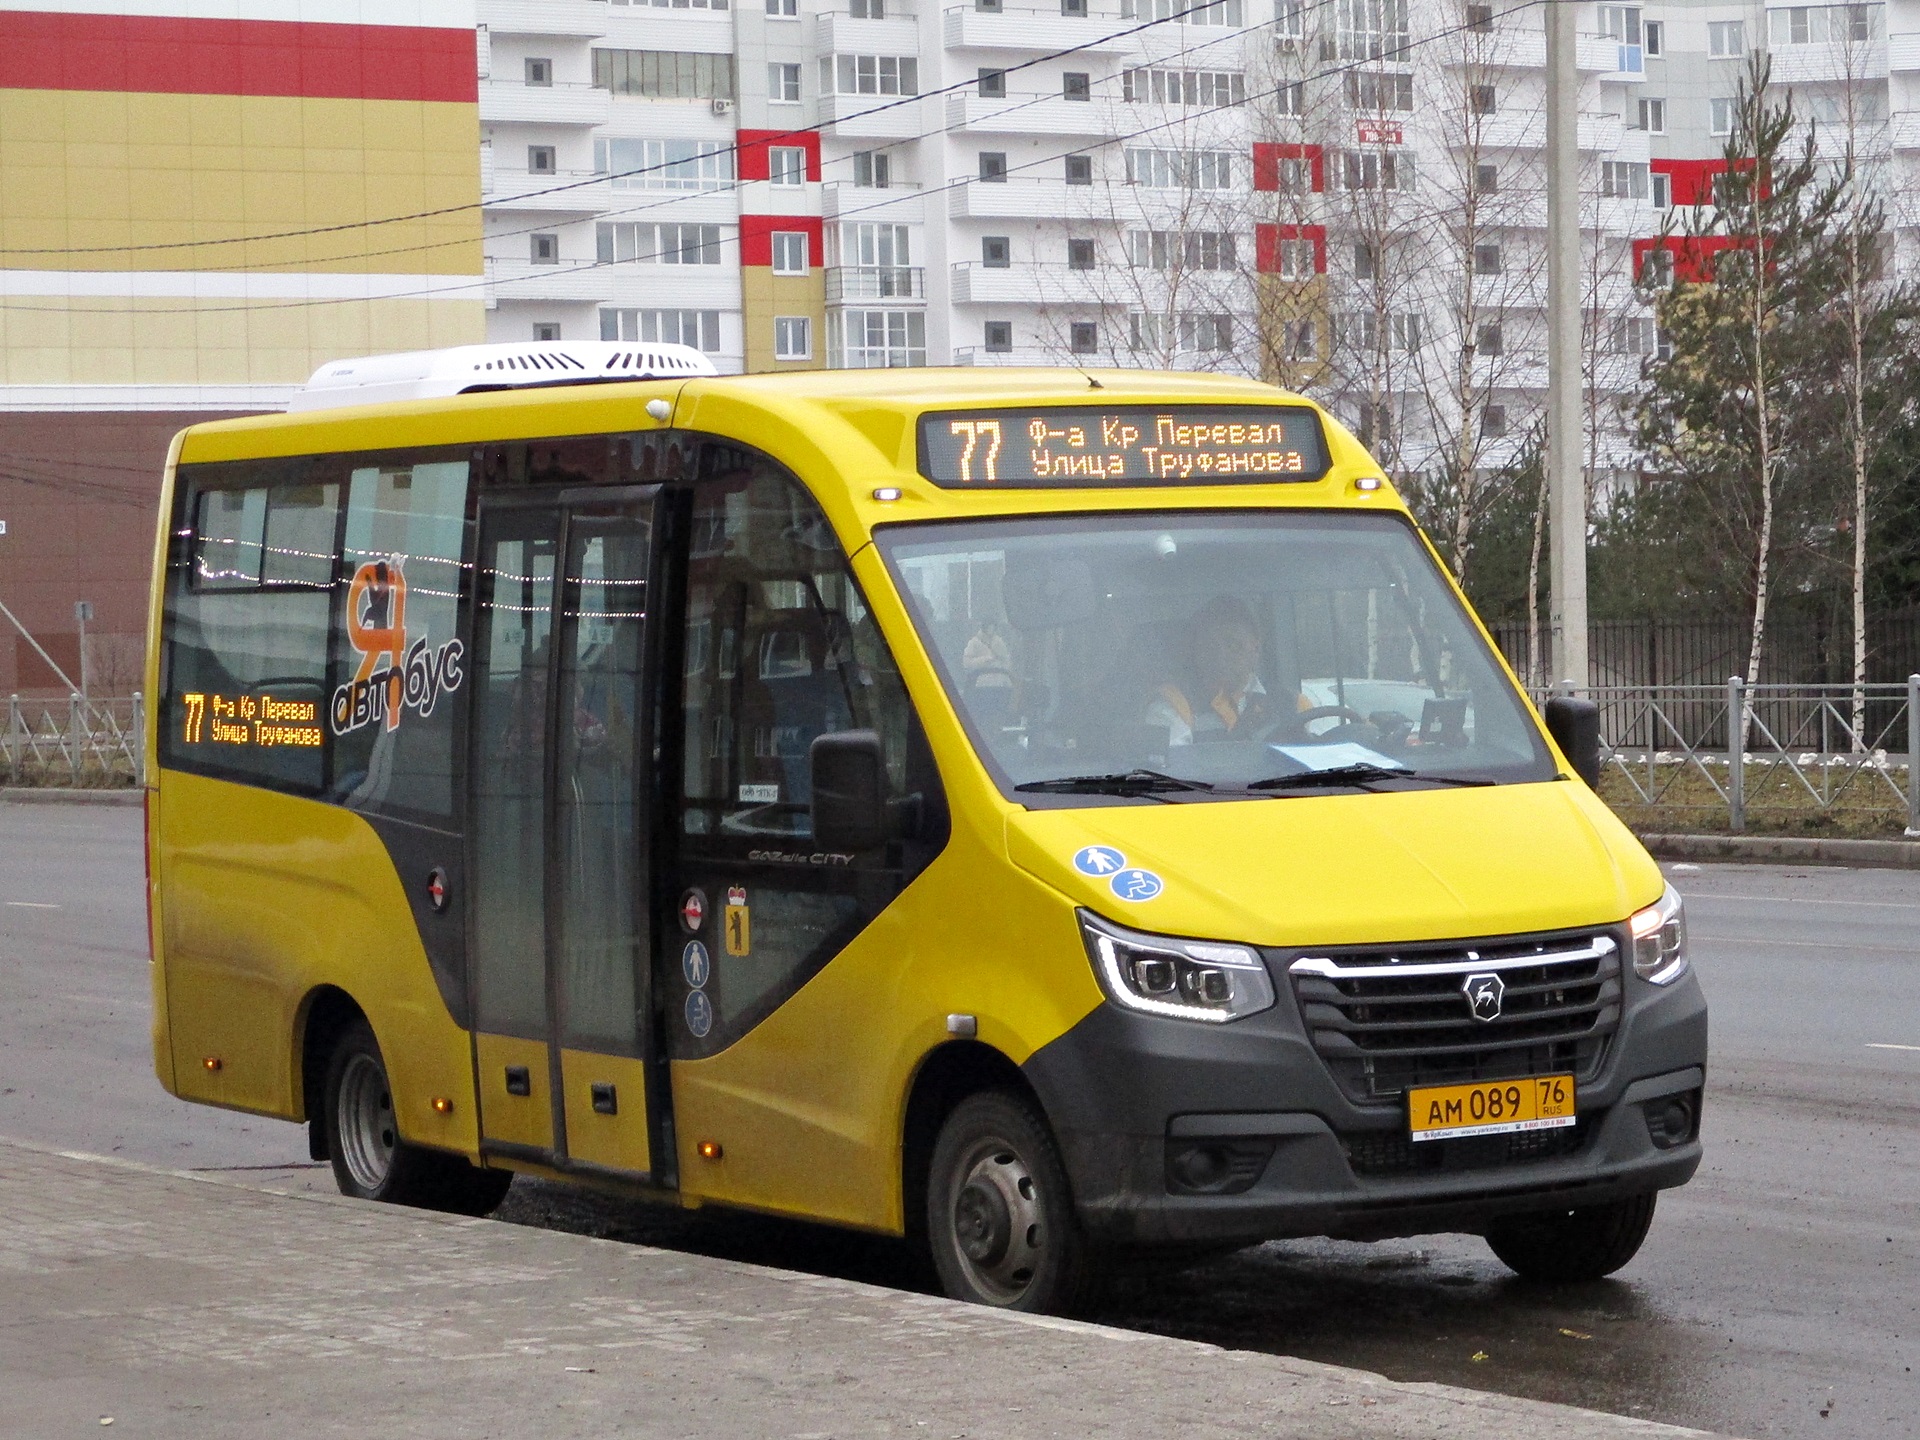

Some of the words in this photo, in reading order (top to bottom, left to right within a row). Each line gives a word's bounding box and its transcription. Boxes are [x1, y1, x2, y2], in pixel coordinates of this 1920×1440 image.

[1029, 418, 1085, 447] Ф-а
[1102, 415, 1139, 449] Кр
[1156, 415, 1281, 448] Перевал
[950, 420, 1001, 481] 77
[1031, 449, 1124, 479] Улица
[1142, 447, 1302, 478] Труфанова
[185, 694, 205, 742] 77
[213, 695, 235, 717] Ф-а
[240, 695, 256, 721] Кр
[262, 696, 314, 722] Перевал
[212, 719, 248, 745] Улица
[254, 720, 320, 746] Труфанова
[809, 853, 855, 865] CITY
[1539, 1080, 1565, 1105] 76
[1543, 1105, 1562, 1116] RUS
